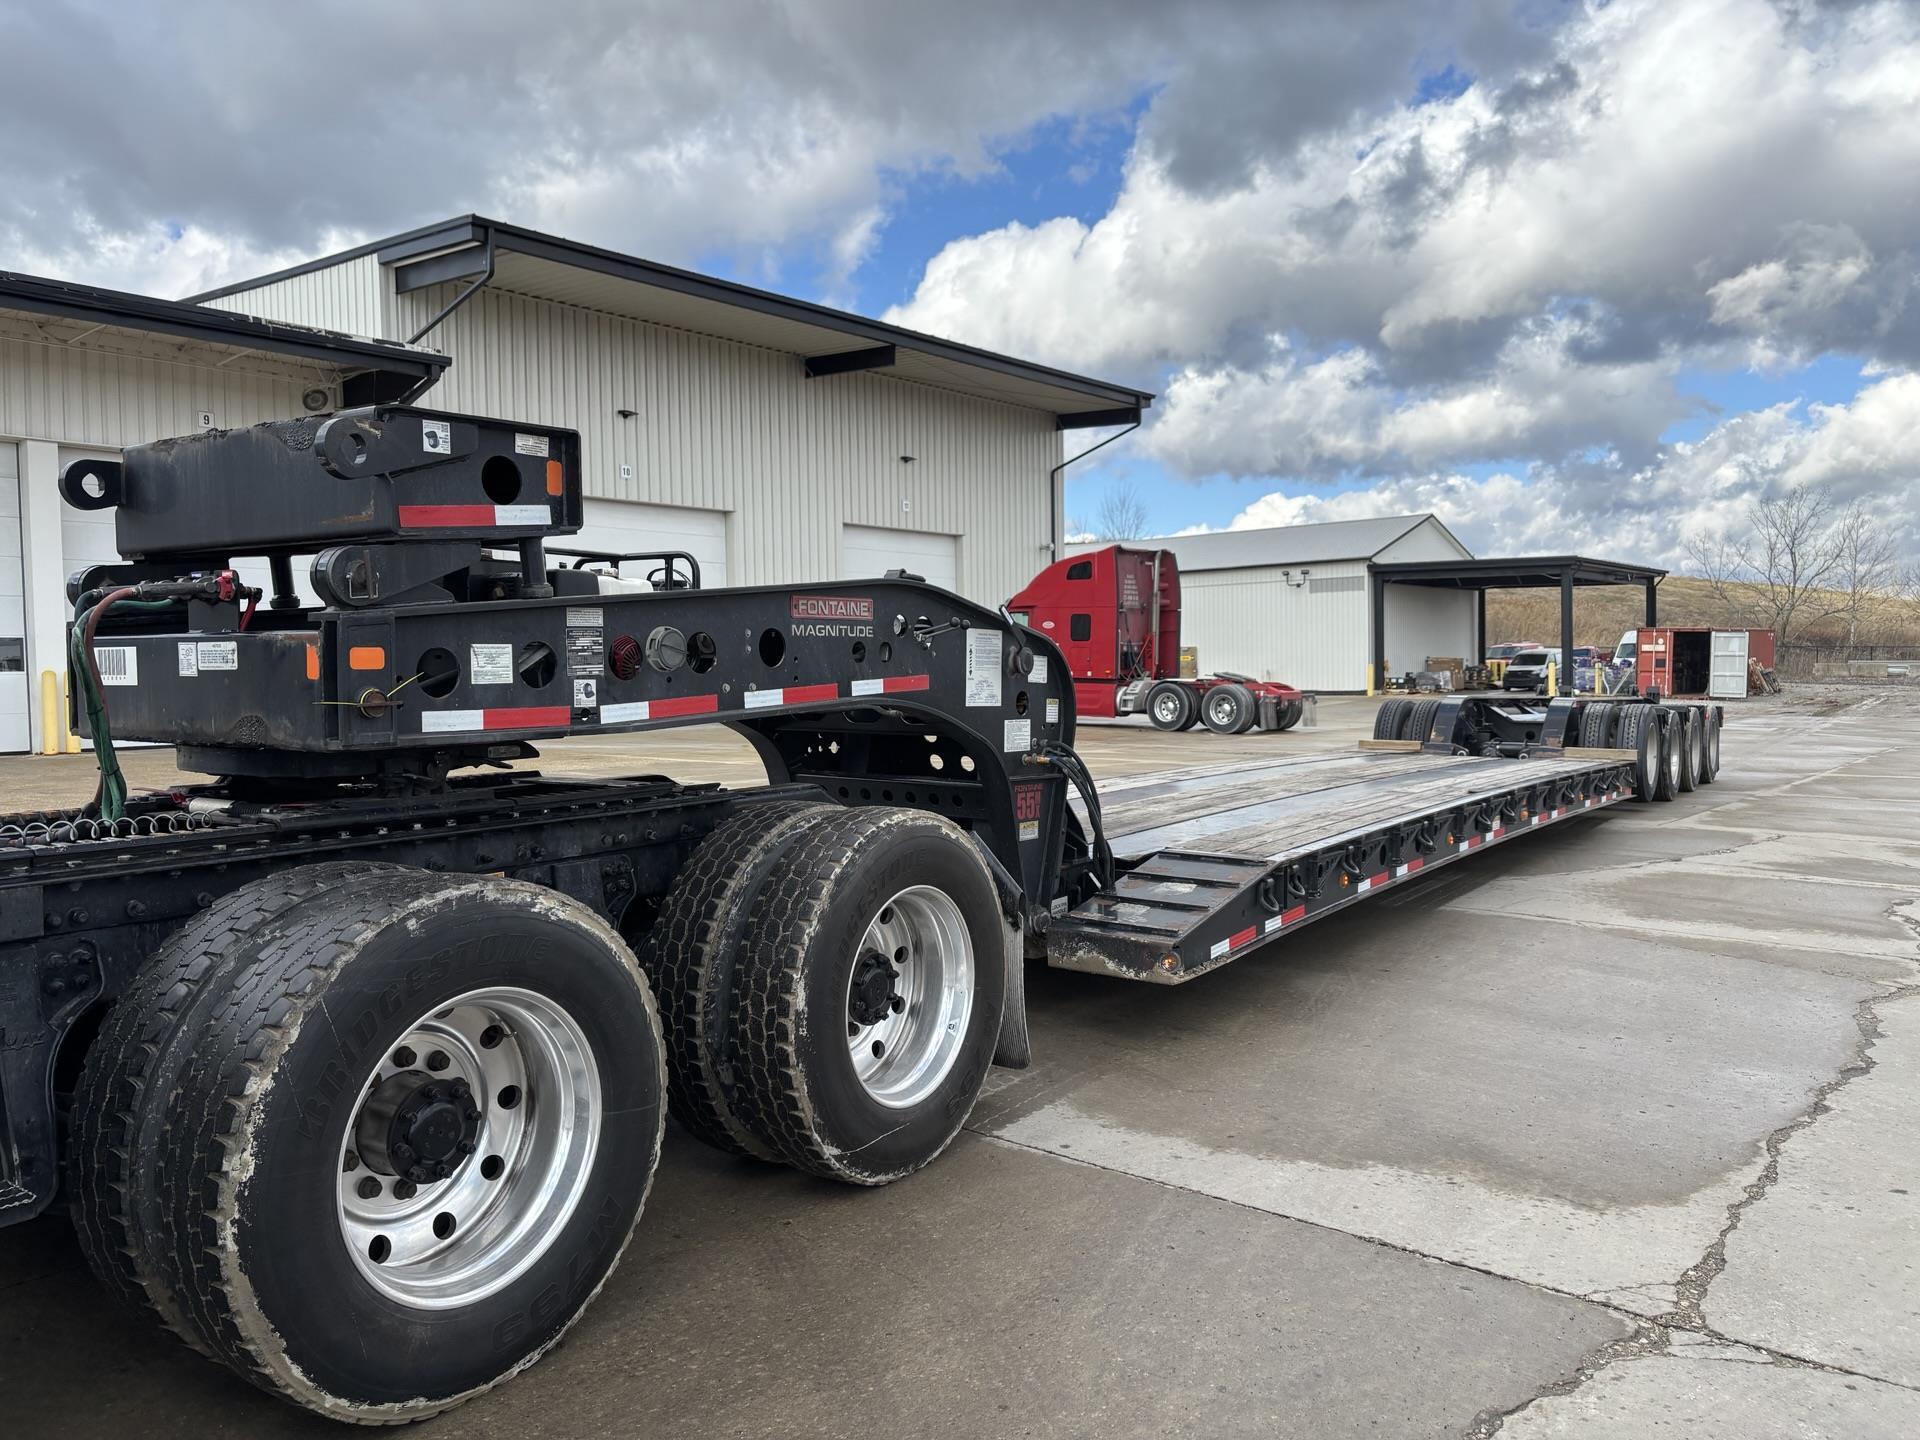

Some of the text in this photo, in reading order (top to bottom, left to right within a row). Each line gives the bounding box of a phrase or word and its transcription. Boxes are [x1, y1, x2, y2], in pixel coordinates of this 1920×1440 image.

[203, 414, 210, 425] 9
[622, 467, 631, 476] 10
[798, 599, 869, 616] FONTAINE
[791, 624, 874, 637] MAGNITUDE
[295, 933, 554, 1143] BRIDGESTONE
